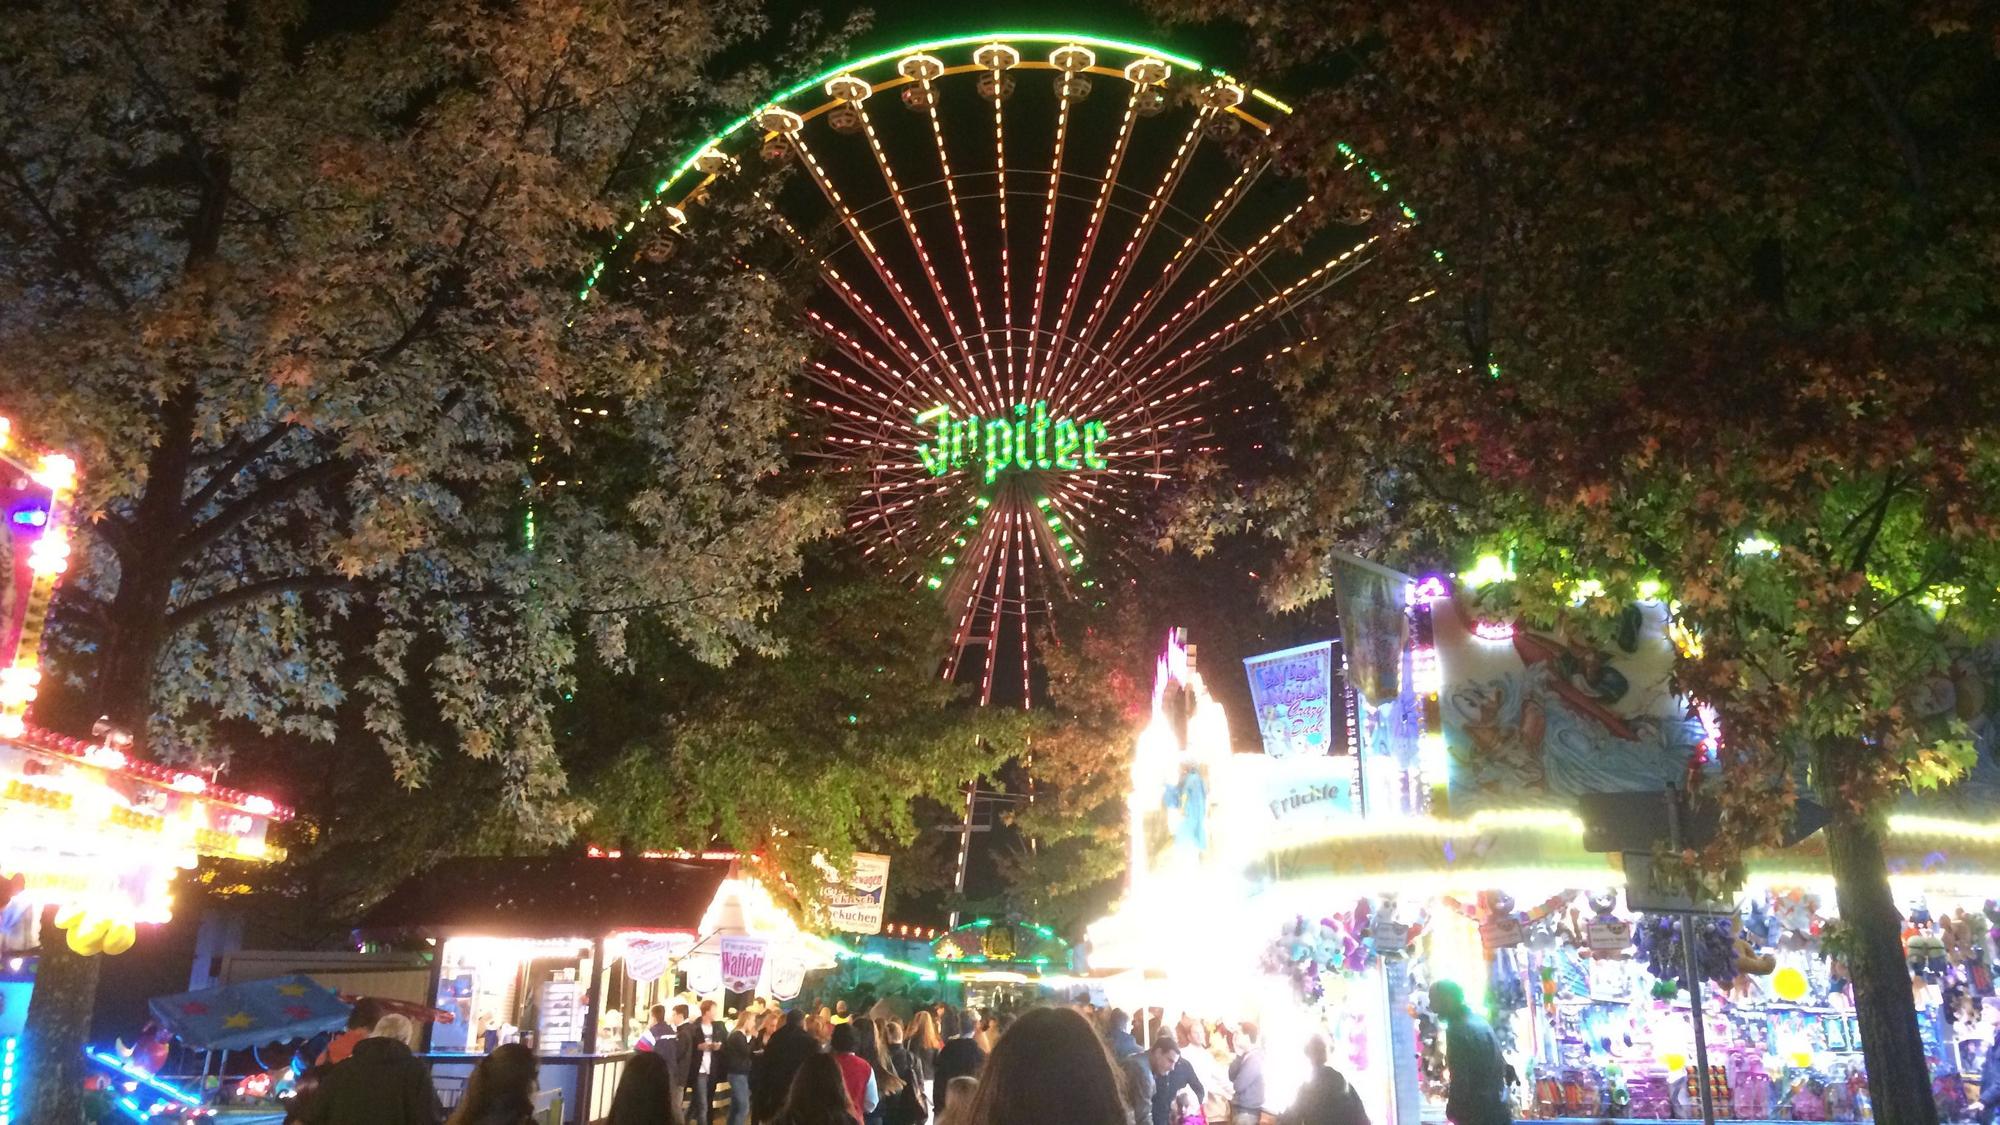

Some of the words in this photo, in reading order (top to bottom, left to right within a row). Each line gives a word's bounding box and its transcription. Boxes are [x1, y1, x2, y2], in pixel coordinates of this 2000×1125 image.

[915, 400, 1109, 485] Jupiter
[1287, 701, 1326, 720] Crazy
[722, 951, 764, 978] Waffeln
